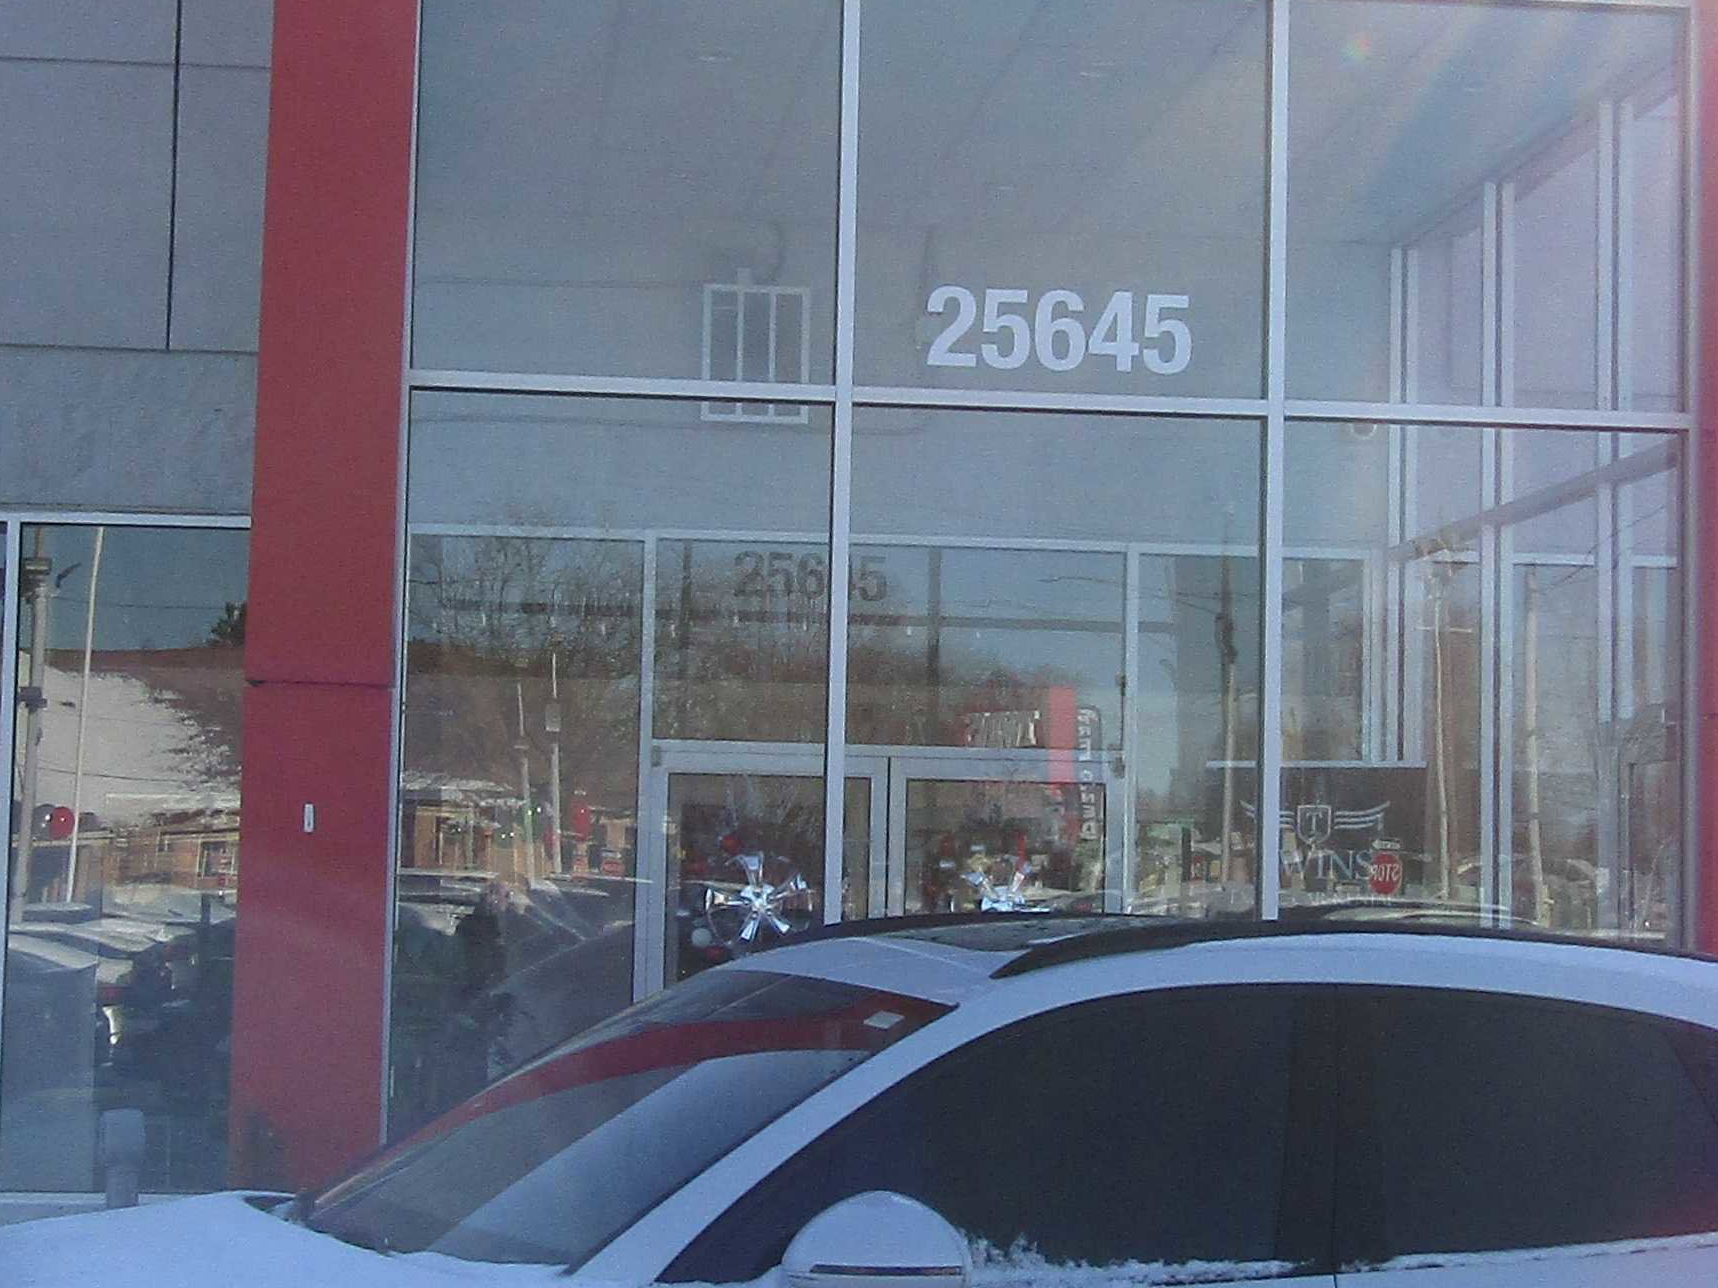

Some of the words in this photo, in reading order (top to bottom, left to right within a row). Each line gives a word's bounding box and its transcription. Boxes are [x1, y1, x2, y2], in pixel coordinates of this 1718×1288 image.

[927, 285, 1192, 375] 25645
[733, 550, 887, 602] 2565
[1280, 848, 1373, 880] WINS
